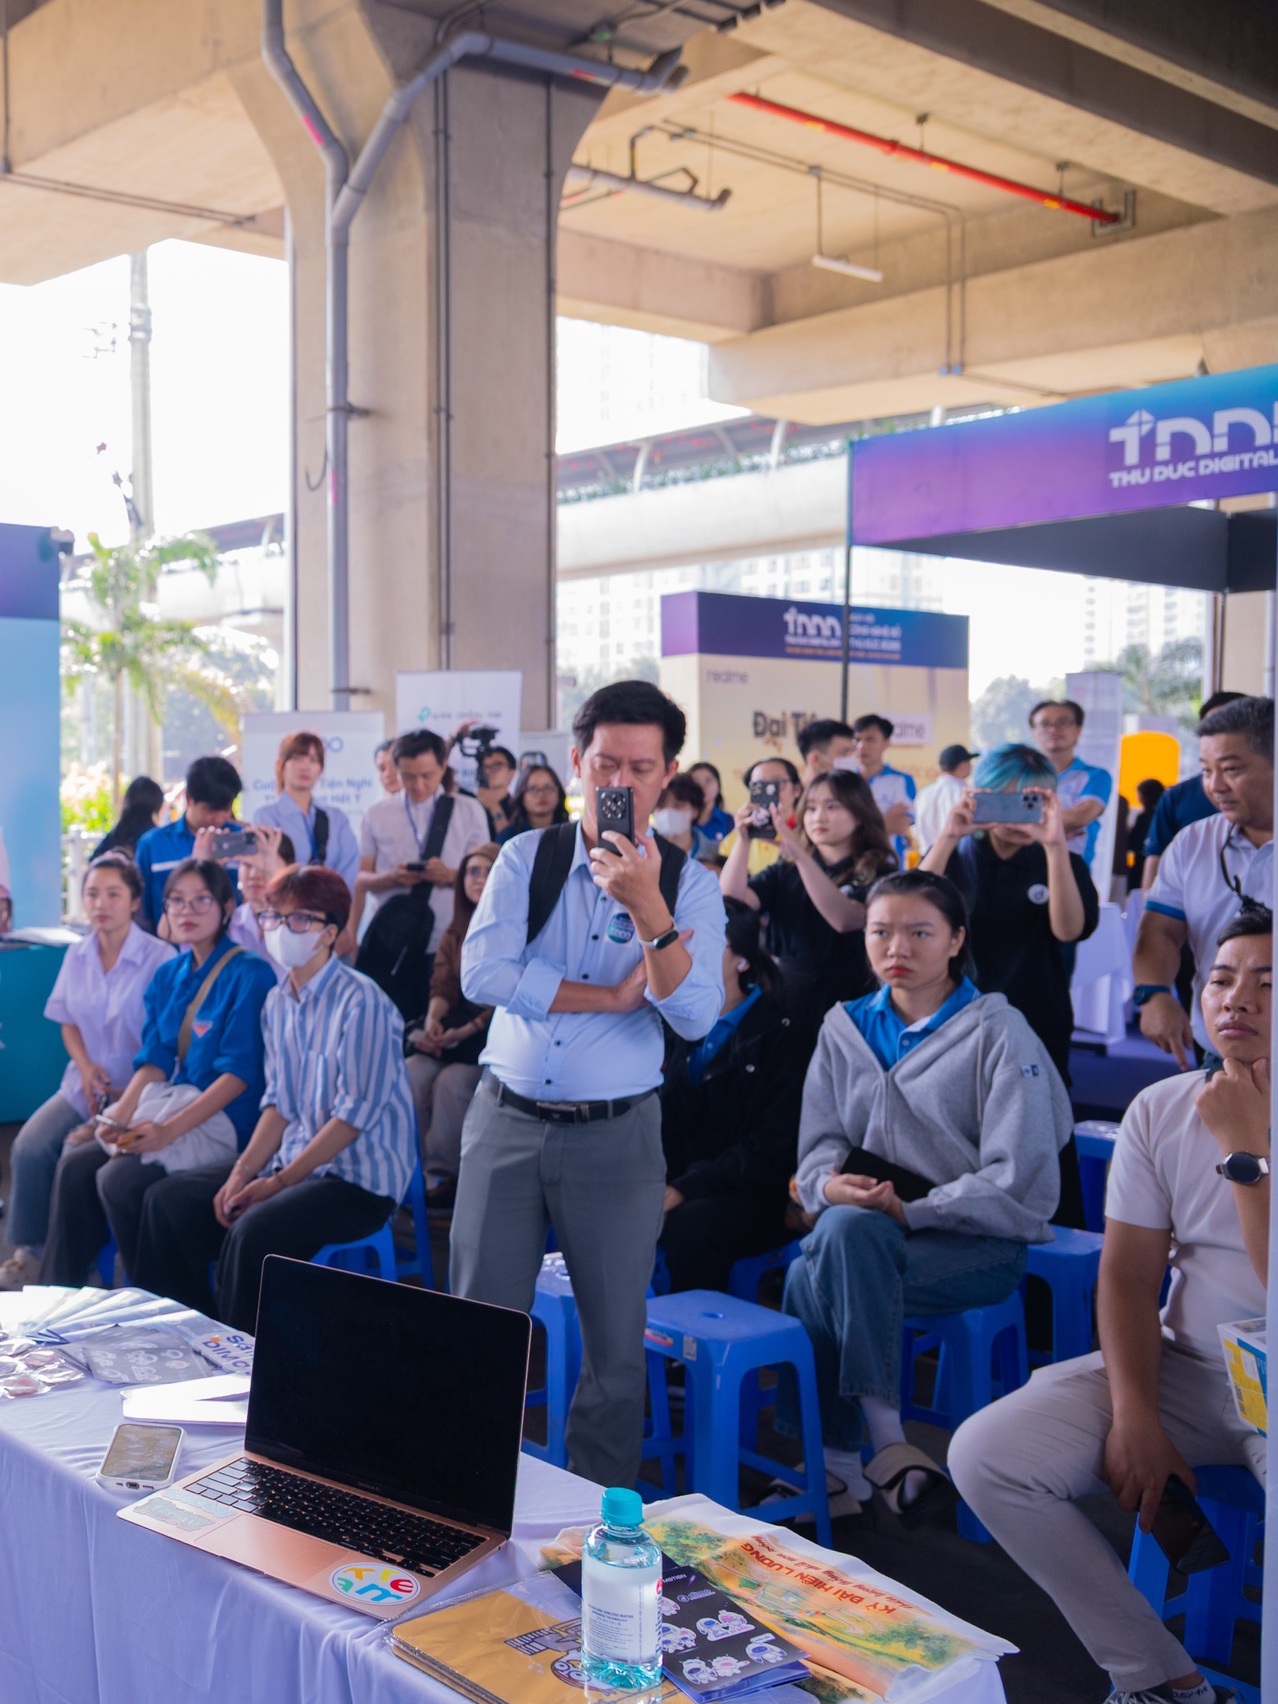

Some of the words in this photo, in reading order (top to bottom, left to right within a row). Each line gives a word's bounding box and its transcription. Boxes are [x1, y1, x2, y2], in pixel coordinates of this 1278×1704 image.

[1108, 467, 1151, 489] THU
[1152, 460, 1197, 483] DUC
[1198, 448, 1278, 477] DIGITAL
[753, 710, 787, 741] Đại
[793, 1571, 834, 1592] HIỀN
[833, 1588, 865, 1604] ĐÀI
